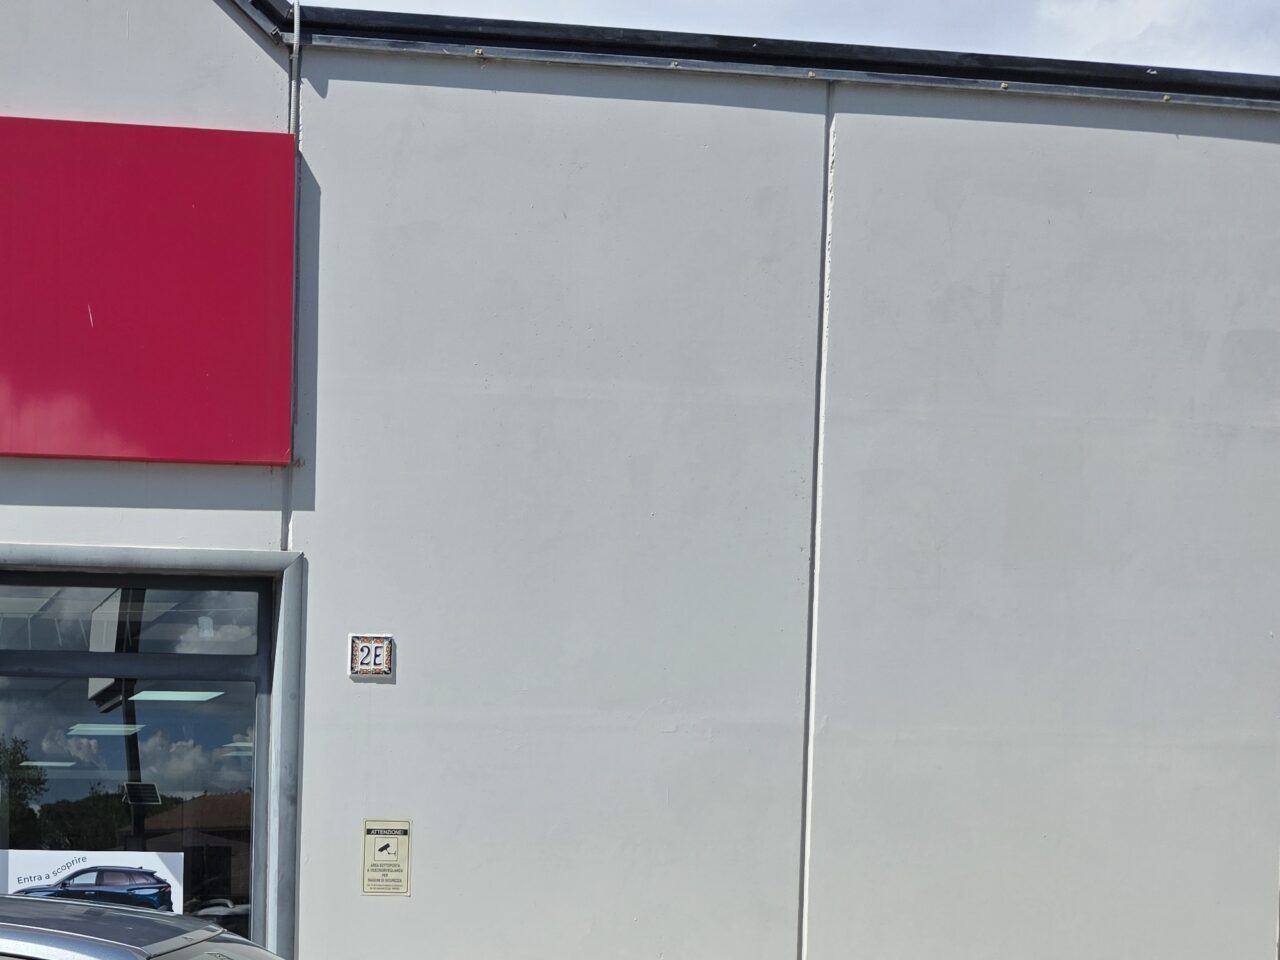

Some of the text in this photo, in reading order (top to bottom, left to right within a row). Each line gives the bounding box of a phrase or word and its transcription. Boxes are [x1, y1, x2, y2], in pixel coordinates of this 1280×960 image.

[360, 645, 383, 666] 2E
[17, 855, 88, 885] Entra a scoprire
